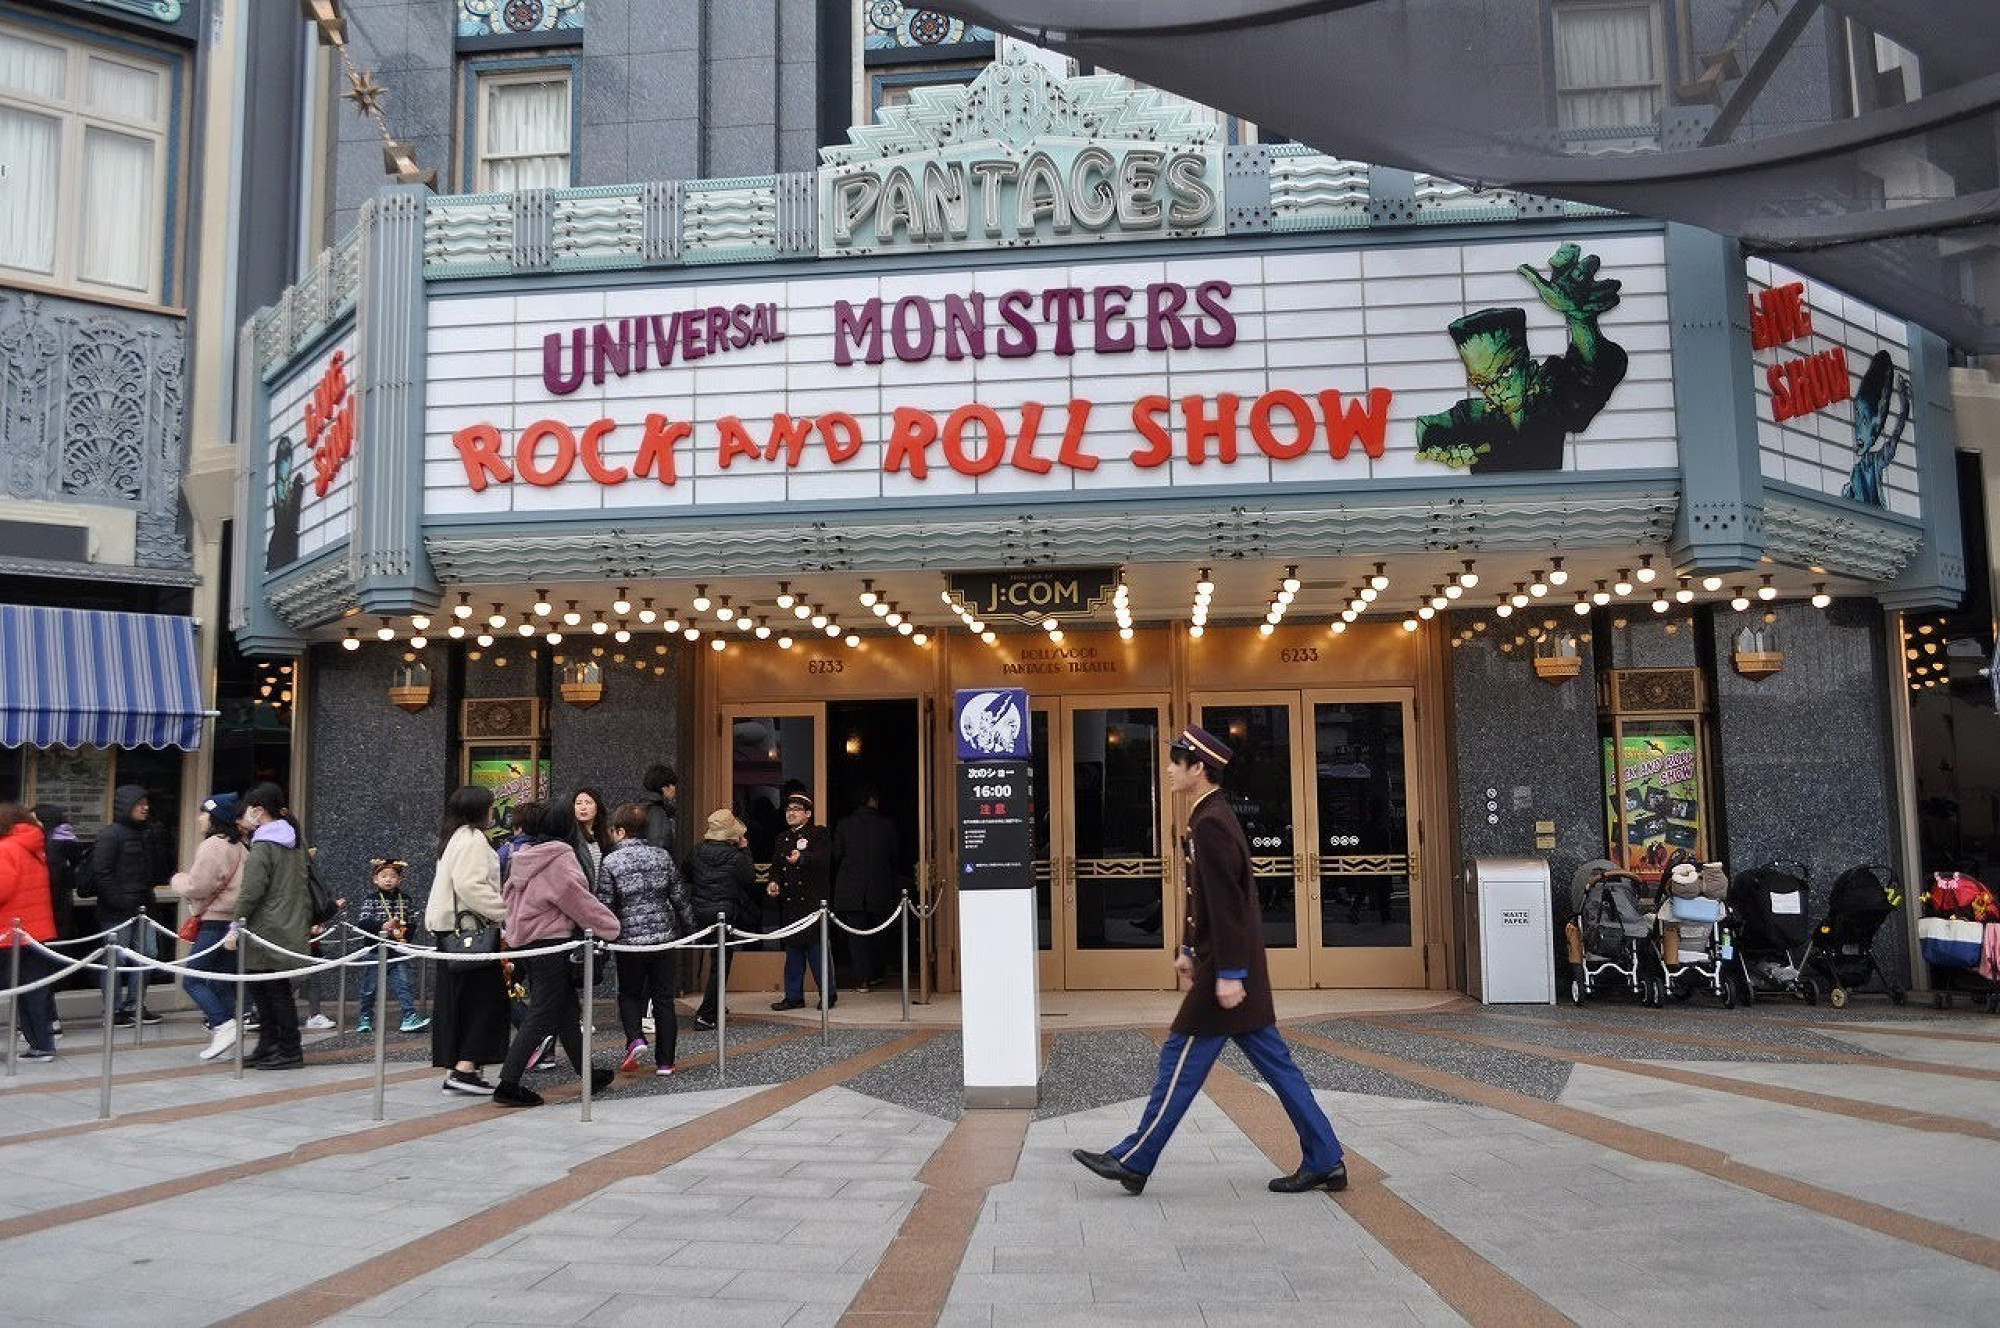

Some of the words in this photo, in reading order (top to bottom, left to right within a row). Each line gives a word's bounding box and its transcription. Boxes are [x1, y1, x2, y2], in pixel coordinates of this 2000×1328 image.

[832, 147, 1217, 246] PANTAGES
[543, 302, 785, 396] UNIVERSAL
[833, 279, 1238, 367] MONSTERS
[1766, 346, 1851, 422] SHOW
[452, 412, 693, 492] ROCK
[716, 411, 862, 468] AND
[883, 398, 1099, 480] ROLL
[1131, 387, 1393, 467] SHOW
[987, 580, 1079, 612] J:COM
[808, 660, 845, 674] 6233
[1280, 648, 1319, 663] 6233
[968, 768, 1015, 779] 次のショー
[972, 784, 1012, 798] 16:00
